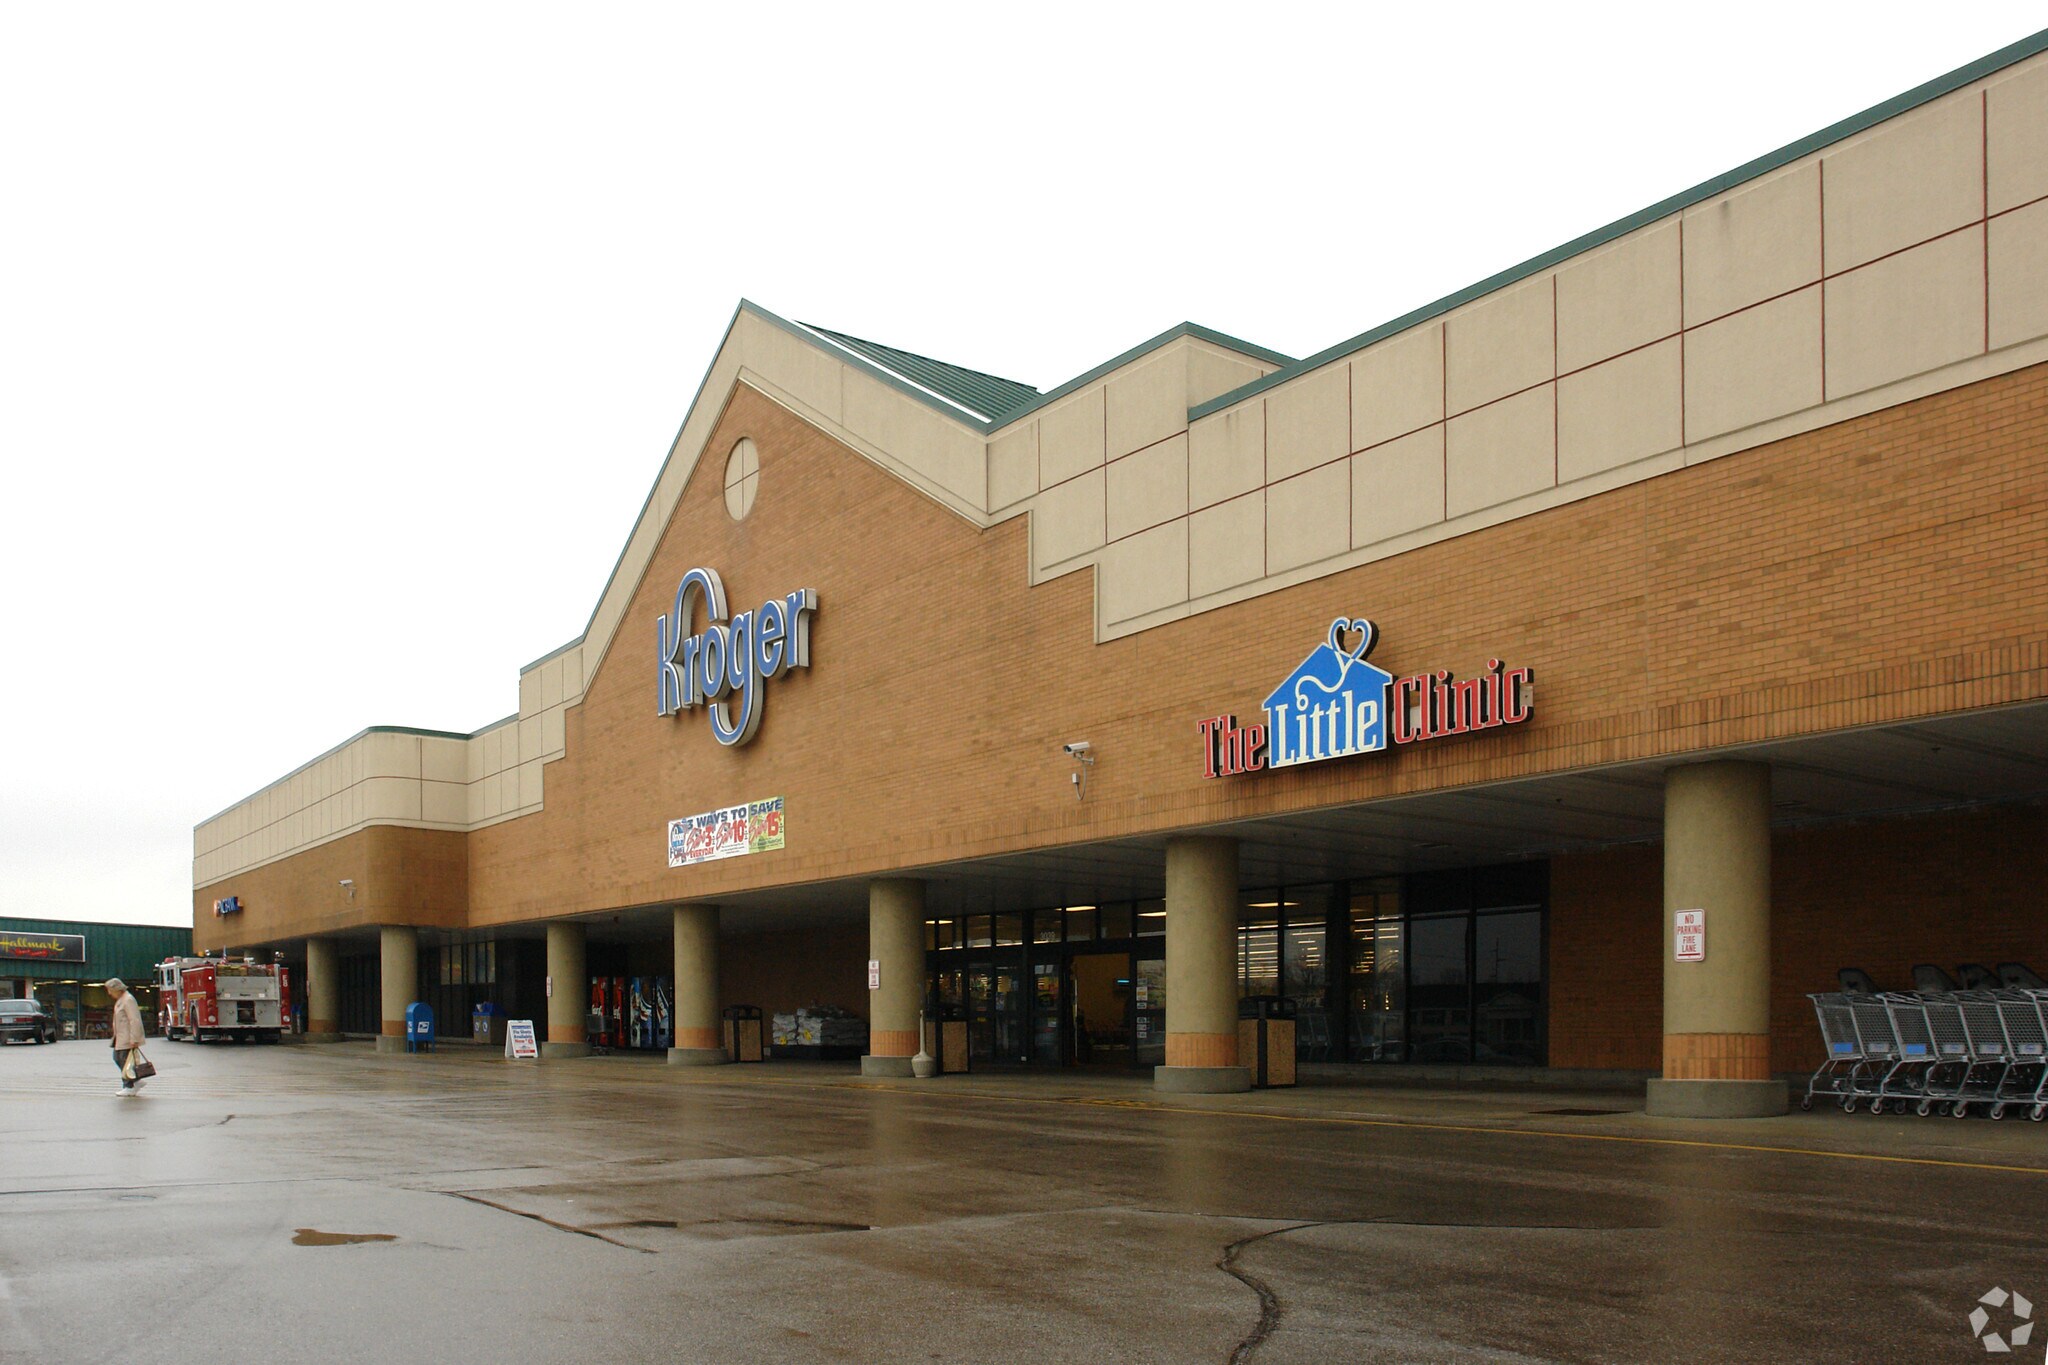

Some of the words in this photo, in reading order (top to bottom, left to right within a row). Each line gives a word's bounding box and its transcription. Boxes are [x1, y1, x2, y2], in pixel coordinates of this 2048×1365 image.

[657, 567, 812, 746] Kroger
[1196, 715, 1267, 779] The
[1274, 690, 1379, 766] Little
[1393, 657, 1531, 745] Clinic
[696, 811, 728, 829] WAYS
[730, 807, 747, 820] TO
[750, 799, 783, 816] SAVE
[1685, 914, 1694, 924] NO
[1677, 925, 1702, 934] PARKING
[0, 936, 65, 953] Hallmark
[1683, 936, 1695, 944] FIRE
